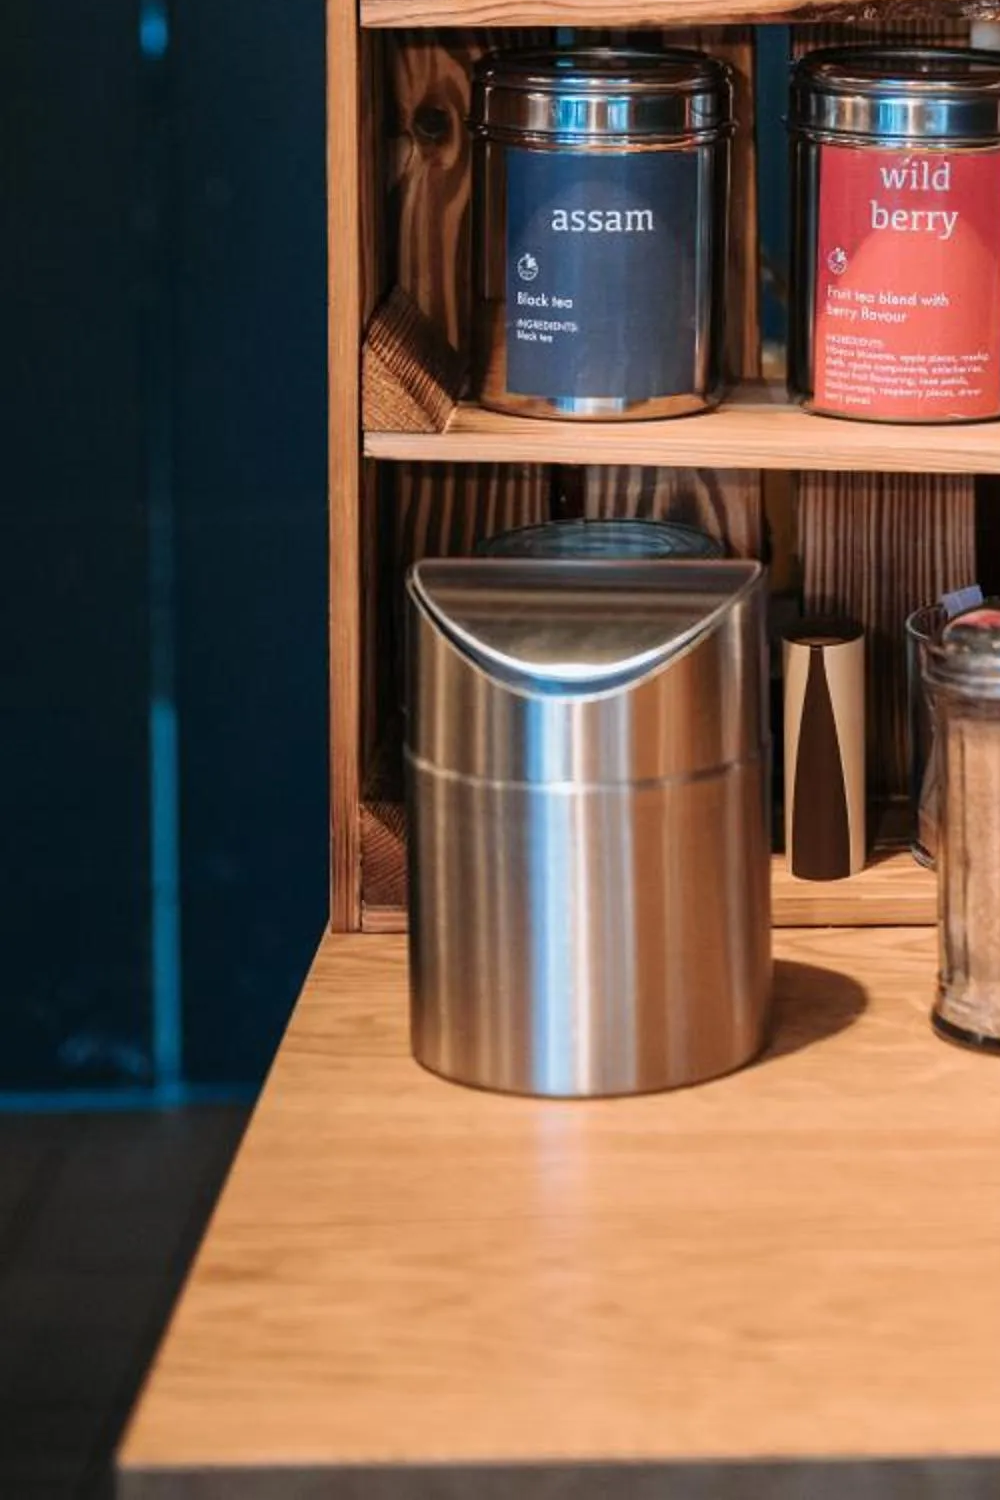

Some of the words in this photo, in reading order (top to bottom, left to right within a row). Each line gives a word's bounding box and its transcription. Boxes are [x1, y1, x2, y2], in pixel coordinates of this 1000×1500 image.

[880, 162, 951, 191] wild
[552, 209, 654, 232] assam
[870, 200, 958, 240] berry
[517, 292, 549, 306] Black
[552, 293, 573, 309] tea
[855, 289, 874, 304] tea
[880, 291, 917, 306] blend
[921, 295, 949, 307] with
[827, 303, 856, 320] berry
[861, 306, 907, 323] flavour
